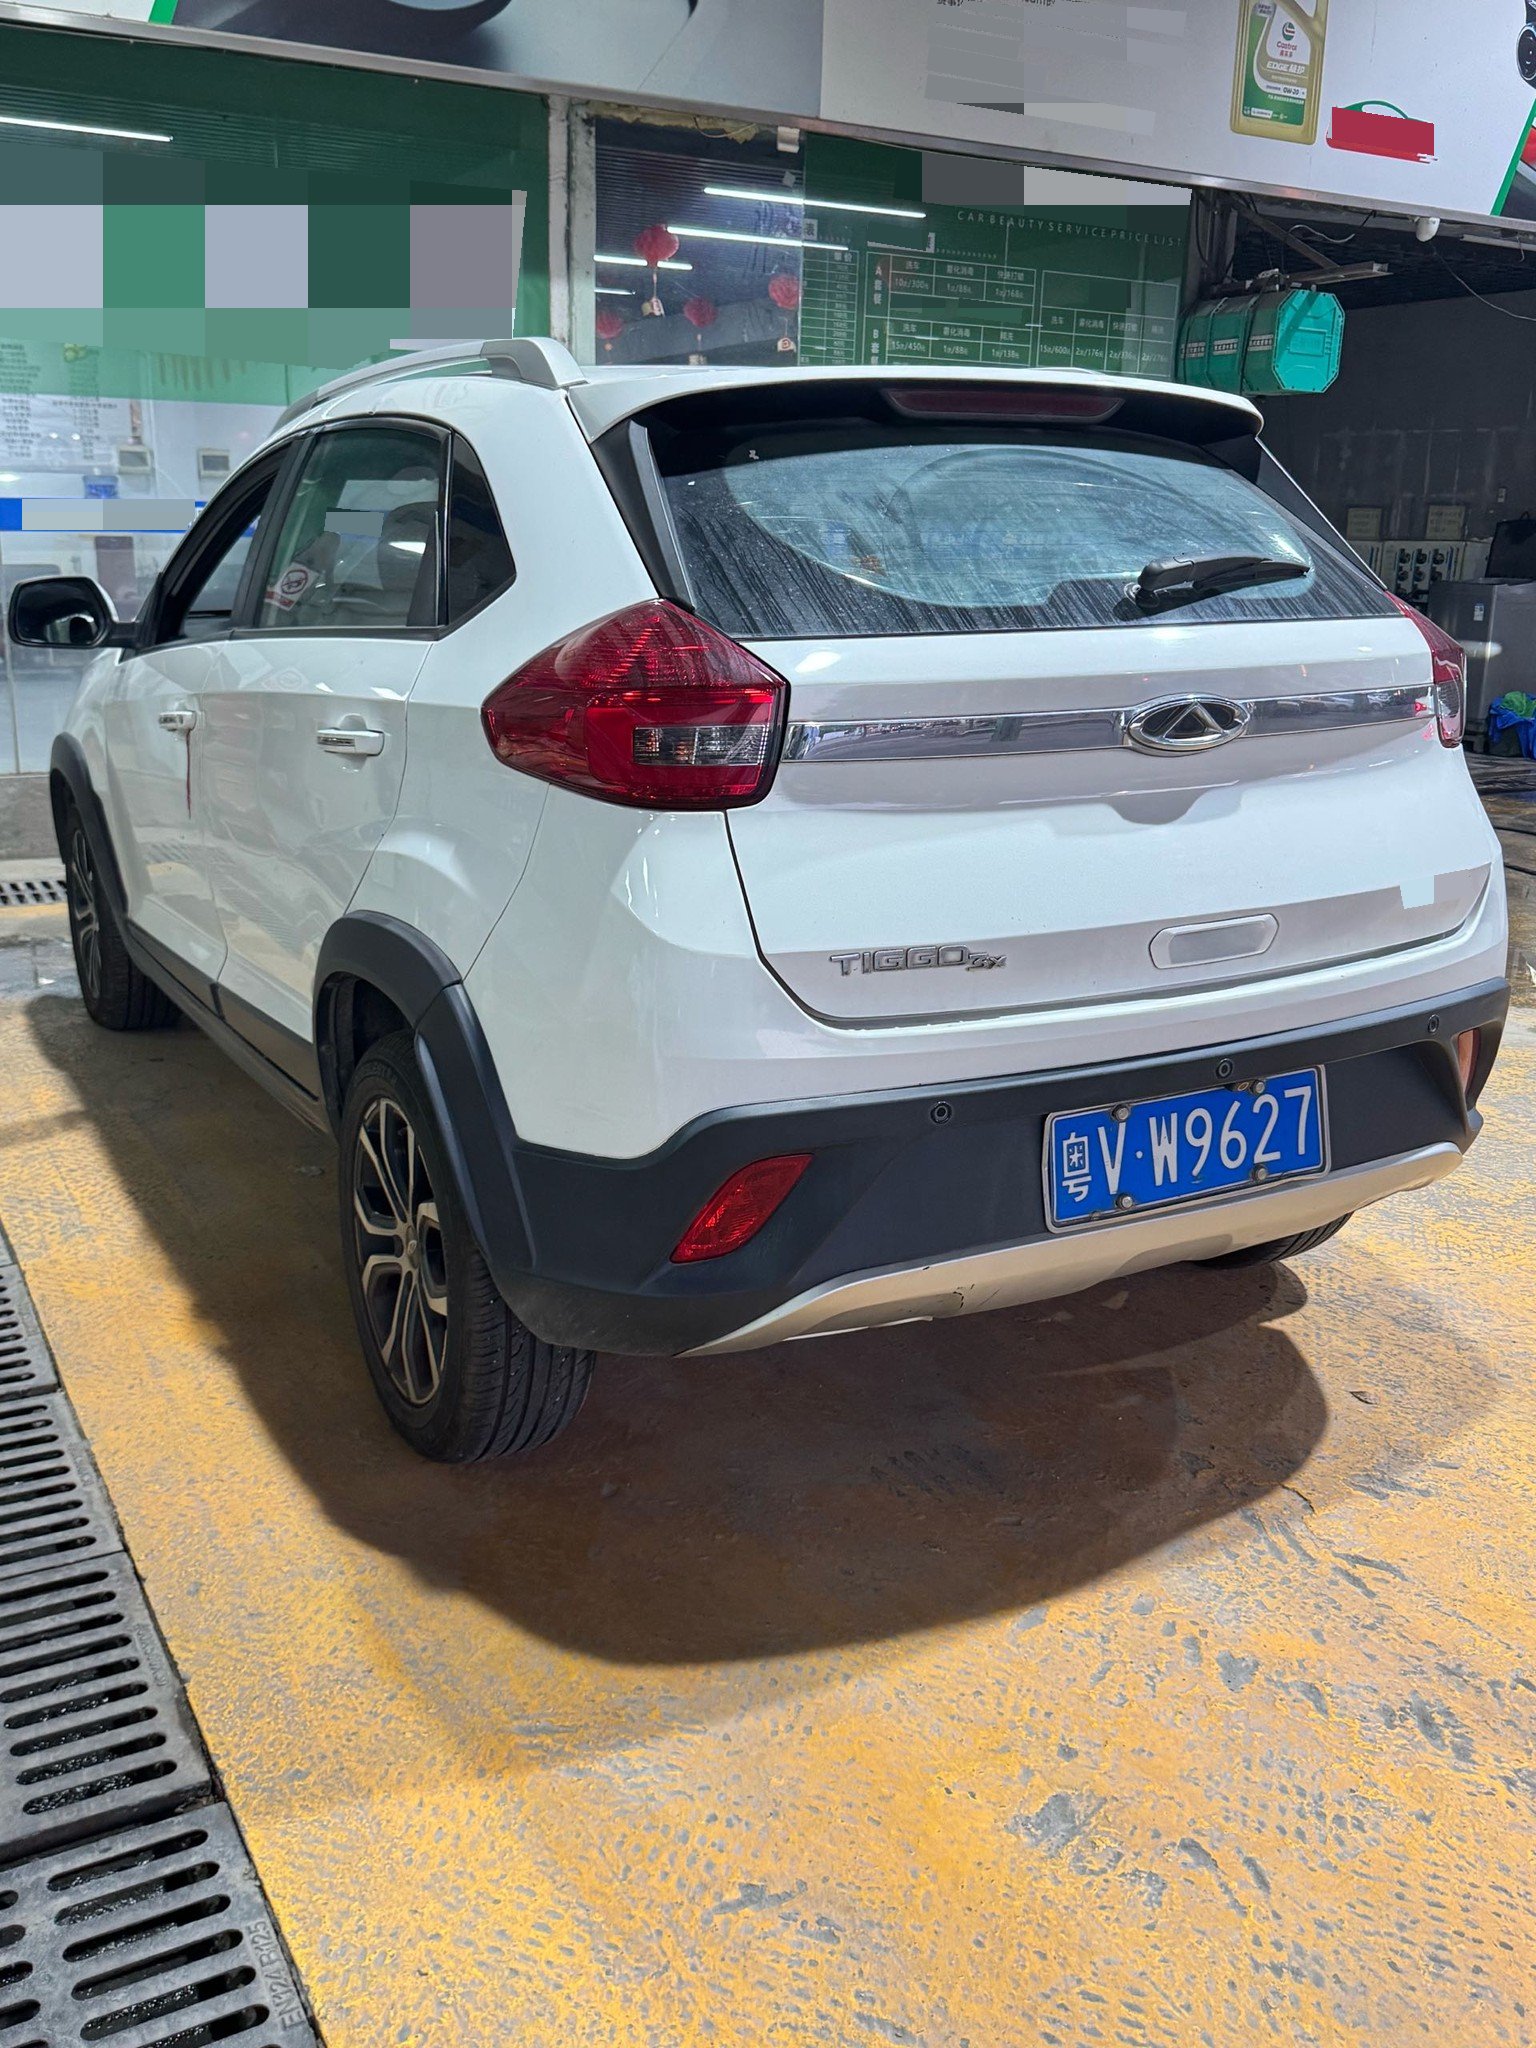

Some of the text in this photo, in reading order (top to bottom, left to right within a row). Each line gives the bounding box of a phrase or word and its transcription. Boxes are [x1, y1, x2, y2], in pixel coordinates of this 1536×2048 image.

[1276, 41, 1297, 51] Castrol
[1267, 61, 1289, 70] EDGE
[957, 210, 1183, 248] CAR BEAUTY SERVICE PRICE LIST
[829, 944, 969, 976] TIGGO
